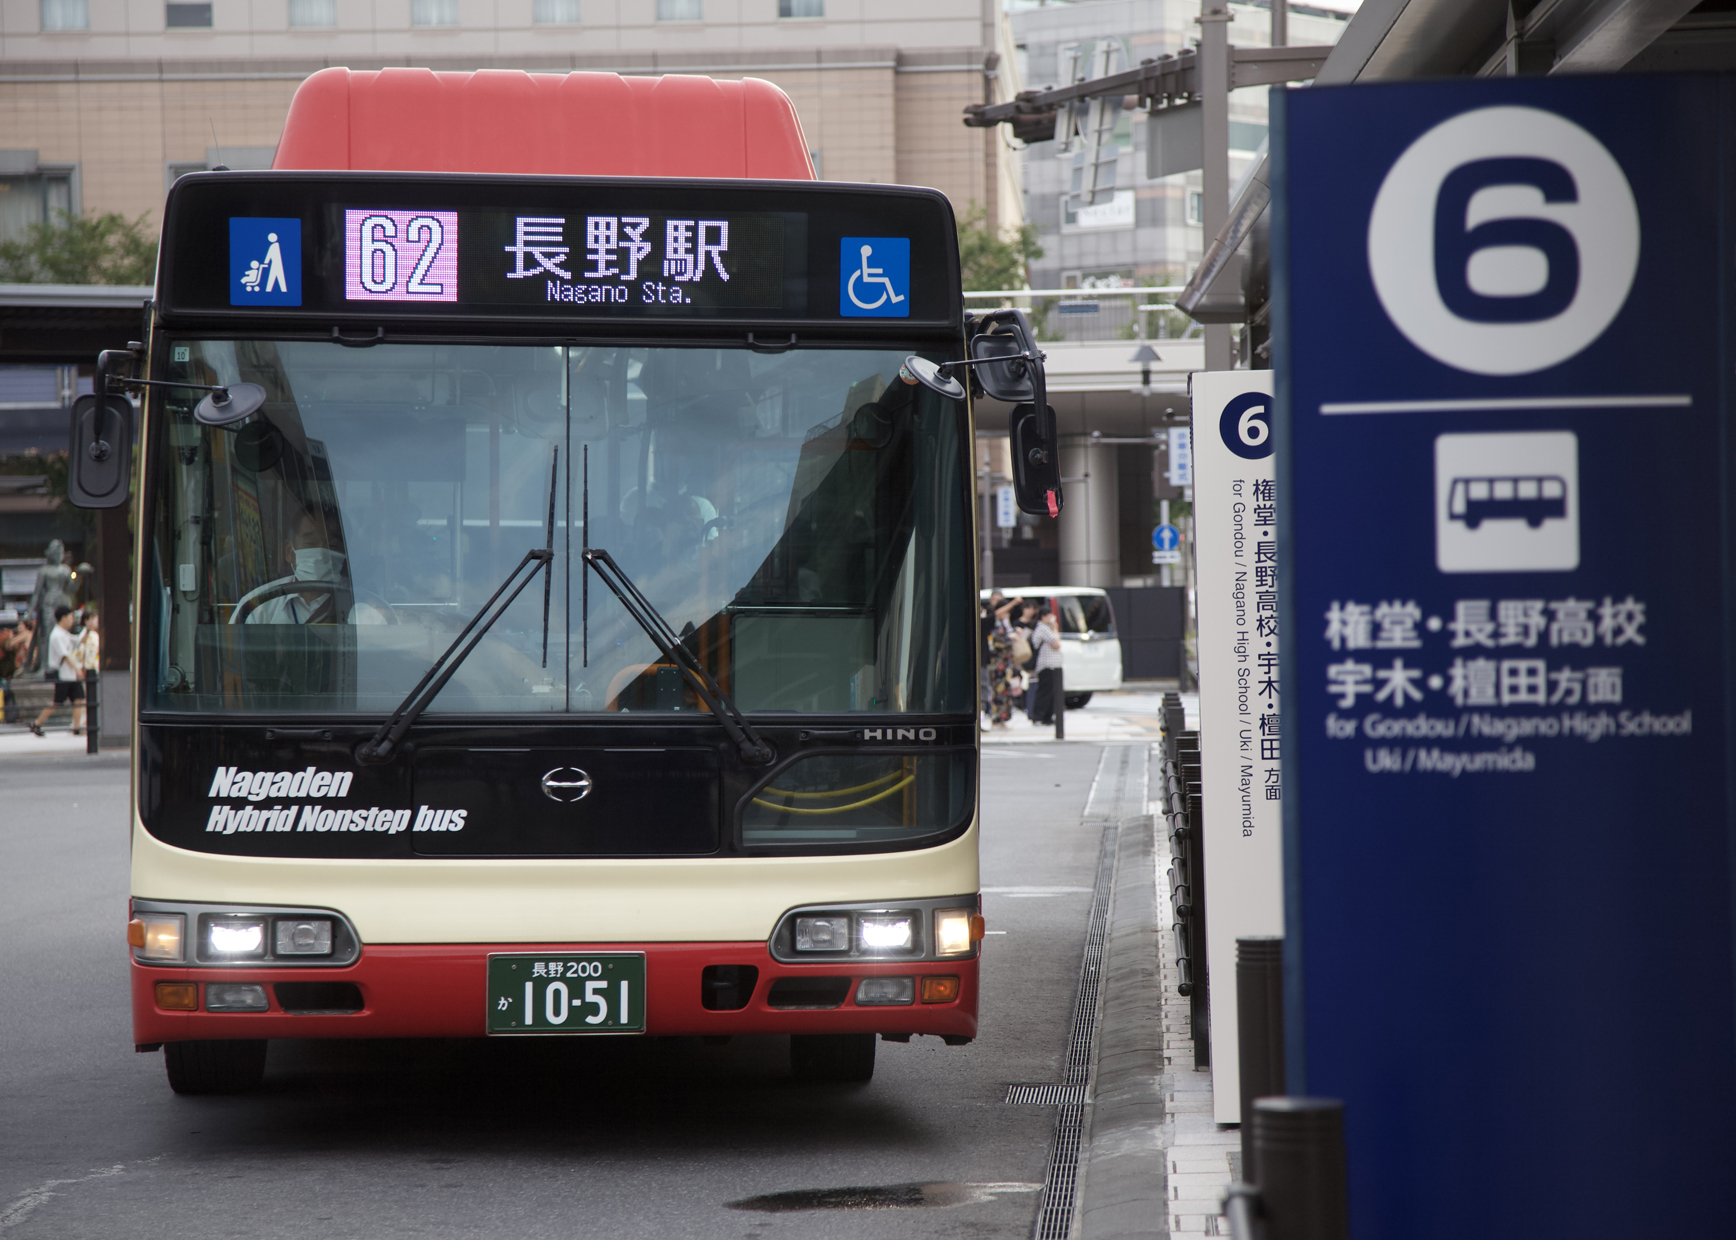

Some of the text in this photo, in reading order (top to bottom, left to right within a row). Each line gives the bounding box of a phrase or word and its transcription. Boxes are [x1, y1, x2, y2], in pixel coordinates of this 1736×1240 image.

[359, 214, 444, 295] 62
[504, 215, 730, 282] 長野駅
[1432, 155, 1581, 325] 6
[547, 280, 692, 304] Nagano Sta.
[1238, 405, 1269, 447] 6
[1232, 478, 1245, 498] for
[1232, 502, 1246, 558] Gondou
[1232, 571, 1248, 626] Nagano
[1324, 595, 1648, 651] 権堂・長野高校
[1234, 631, 1250, 663] High
[1237, 667, 1252, 716] School
[1325, 657, 1623, 709] 宇木・檀田方面
[864, 727, 937, 741] HINO
[1239, 729, 1253, 752] Uki
[1326, 712, 1358, 739] for
[1362, 712, 1455, 739] Gondou
[1470, 712, 1559, 743] Nagano
[1561, 711, 1616, 742] High
[1618, 709, 1693, 738] School
[208, 766, 354, 801] Nagaden
[1364, 746, 1402, 773] Uki
[1417, 746, 1535, 778] Mayumida
[205, 804, 468, 835] Hybrid Nonstep bus
[1238, 765, 1255, 838] Mayumida
[497, 980, 629, 1026] か 10-51
